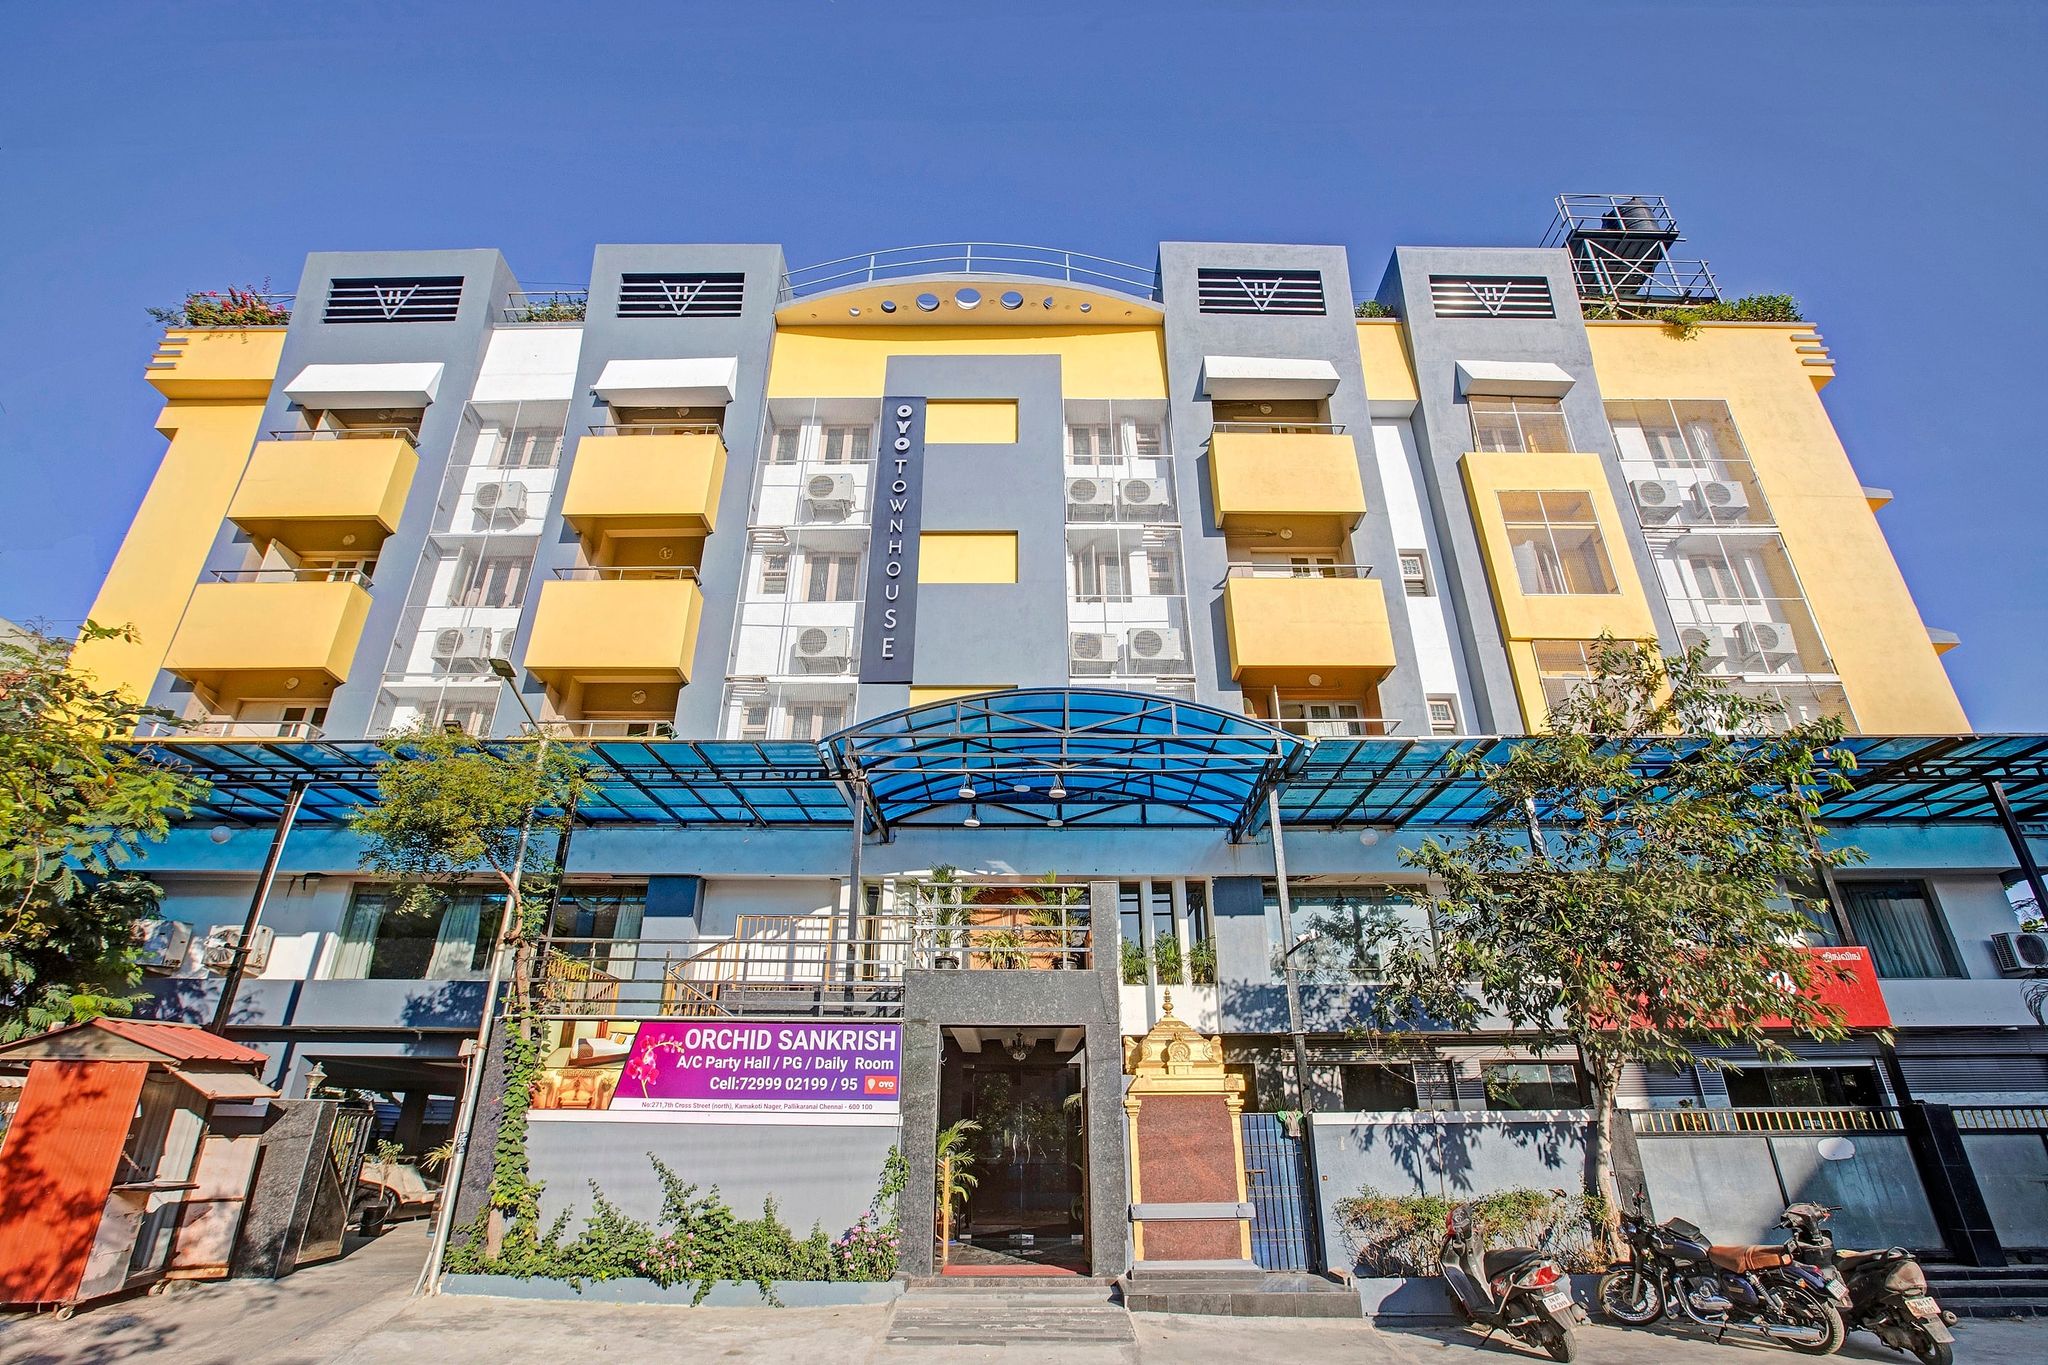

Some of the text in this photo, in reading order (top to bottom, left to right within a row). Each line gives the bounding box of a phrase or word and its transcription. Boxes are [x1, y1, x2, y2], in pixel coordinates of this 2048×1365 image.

[881, 404, 913, 659] OYO TOWNHOUSE
[684, 1028, 897, 1052] ORCHID SANKRISH
[677, 1055, 895, 1073] A/C Party Hall / PG / Daily Room
[710, 1076, 859, 1092] Cell:72999 02199 / 95
[878, 1081, 895, 1089] OYO
